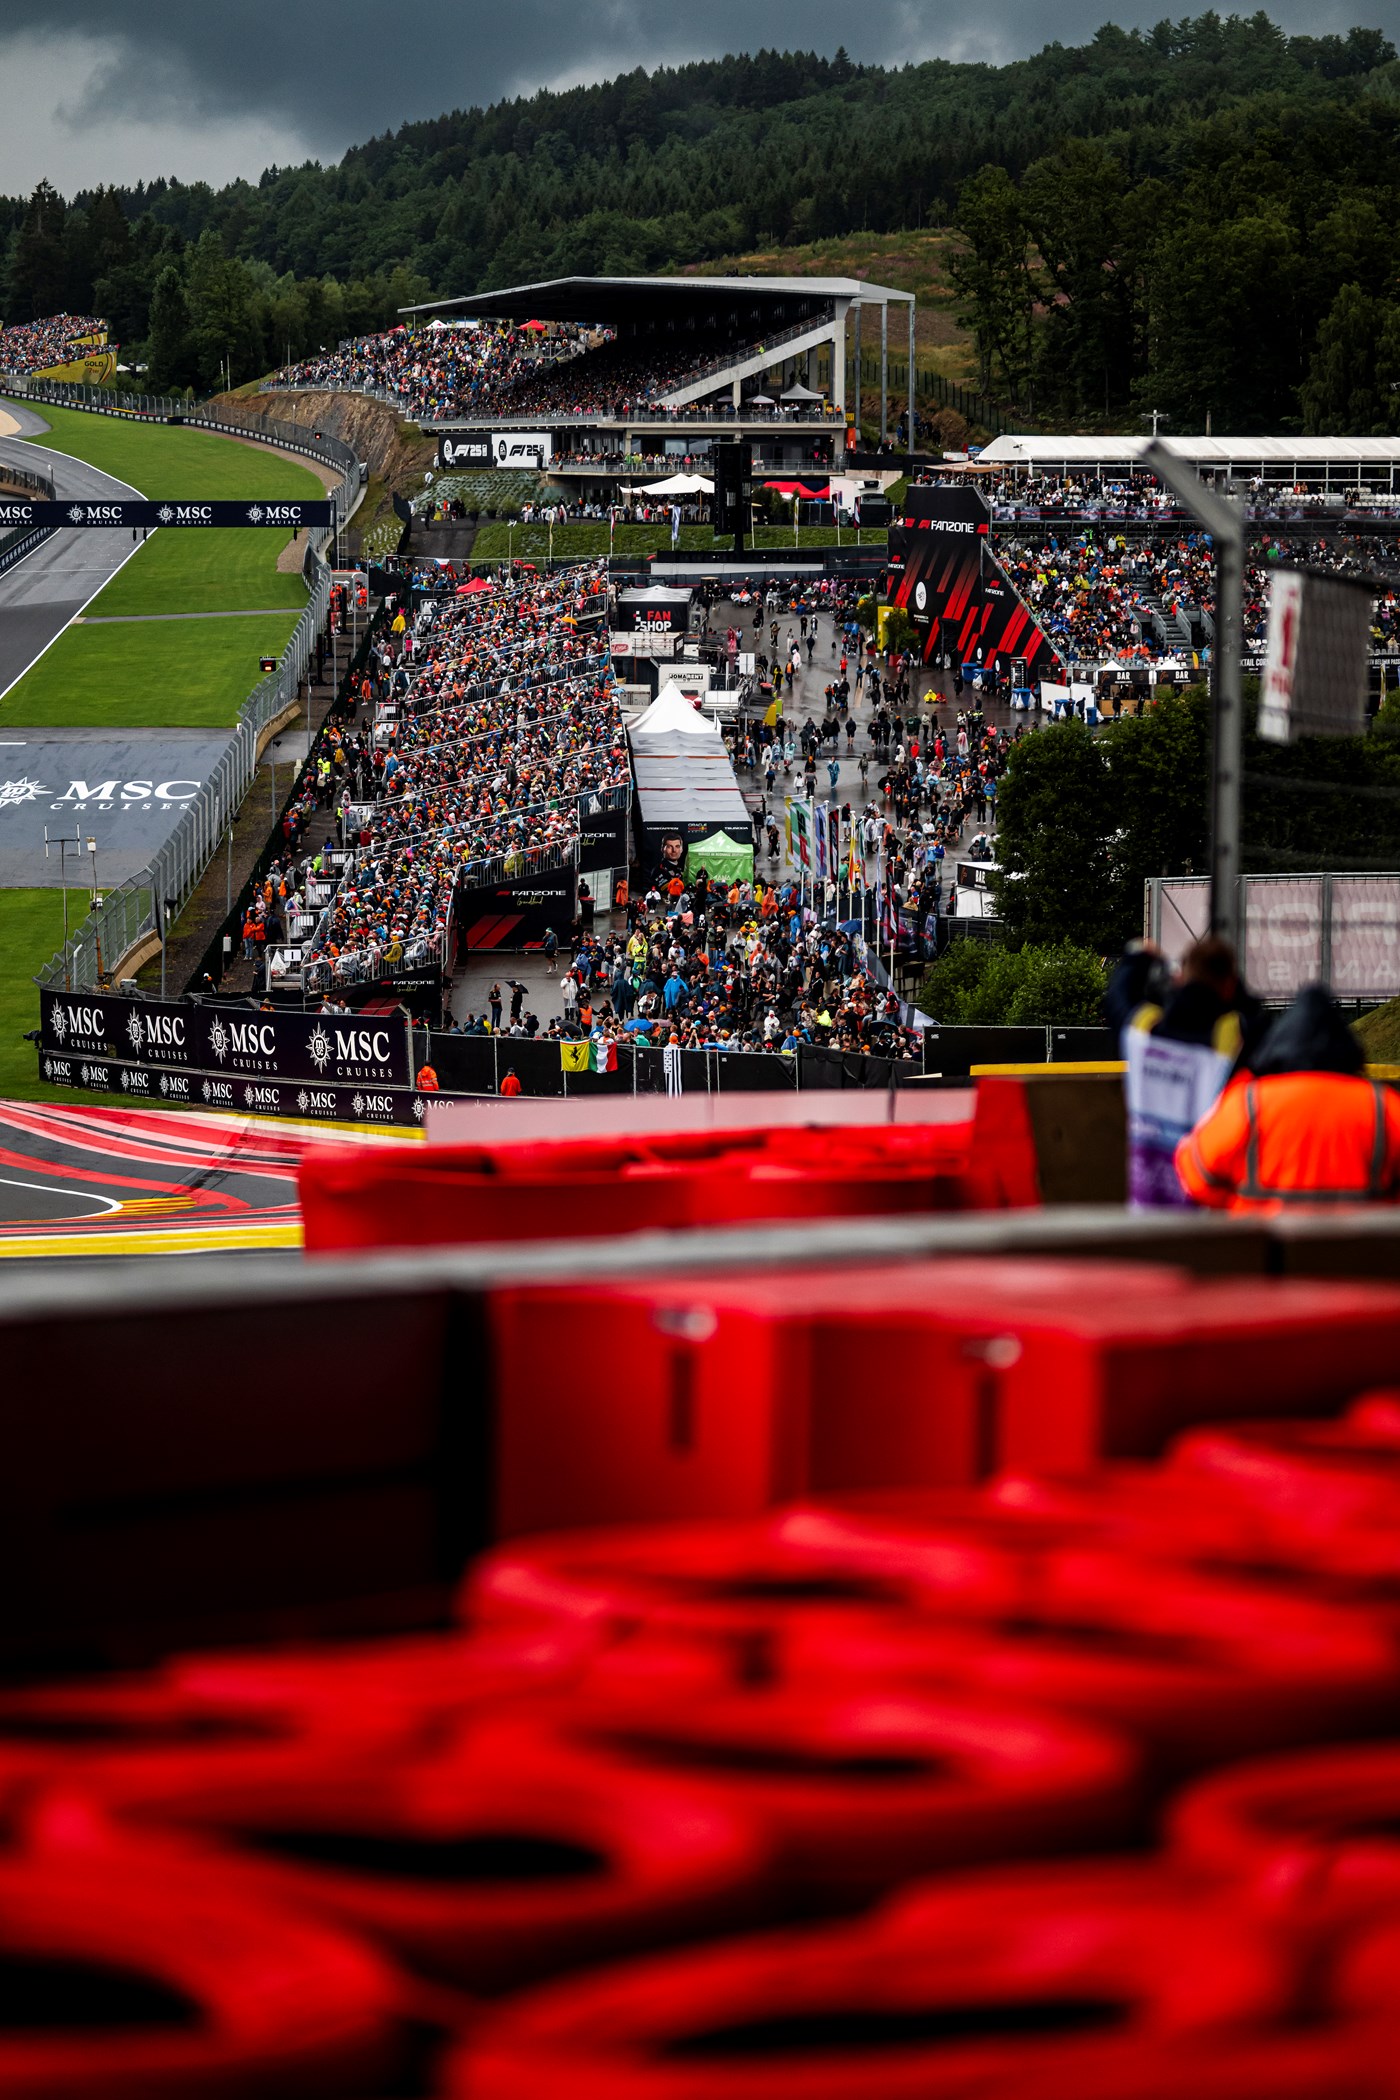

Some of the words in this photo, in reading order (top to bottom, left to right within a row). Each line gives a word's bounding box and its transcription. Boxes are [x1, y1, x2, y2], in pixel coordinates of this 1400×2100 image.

[0, 507, 33, 519] MSC
[87, 507, 122, 519] MSC
[176, 507, 212, 519] MSC
[266, 507, 301, 519] MSC
[931, 520, 974, 533] FANZONE
[647, 610, 671, 620] FAN
[640, 621, 672, 632] SHOP
[1117, 672, 1130, 680] BAR
[1175, 671, 1189, 679] BAR
[56, 781, 201, 800] MSC
[67, 1006, 105, 1037] MSC
[145, 1015, 185, 1046] MSC
[71, 1039, 108, 1051] CRUISES
[229, 1023, 276, 1055] MSC
[335, 1030, 390, 1062] MSC
[148, 1049, 187, 1060] CRUISES
[53, 1061, 71, 1076] MSC
[233, 1058, 278, 1071] CRUISES
[90, 1066, 108, 1082] MSC
[130, 1072, 149, 1087] MSC
[337, 1067, 392, 1078] CRUISES
[169, 1077, 189, 1092] MSC
[212, 1082, 232, 1098] MSC
[255, 1088, 279, 1103] MSC
[310, 1092, 336, 1108] MSC
[366, 1095, 393, 1112] MSC
